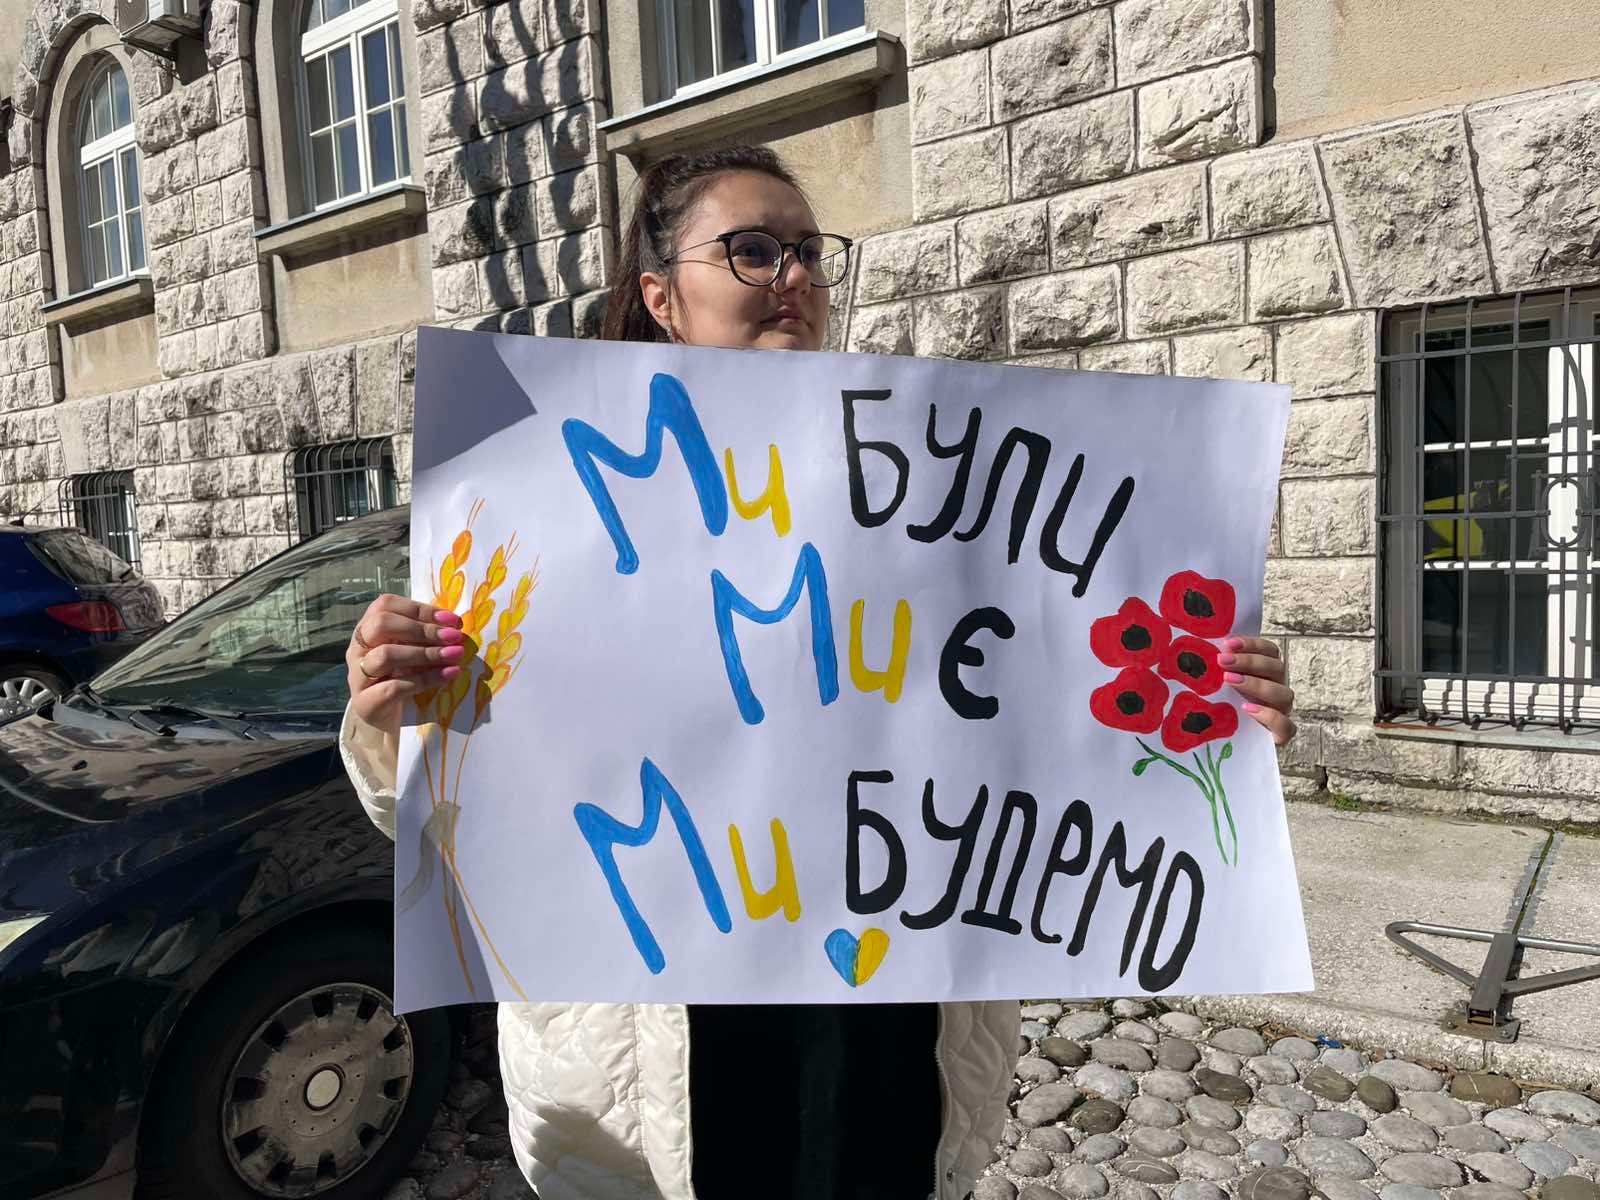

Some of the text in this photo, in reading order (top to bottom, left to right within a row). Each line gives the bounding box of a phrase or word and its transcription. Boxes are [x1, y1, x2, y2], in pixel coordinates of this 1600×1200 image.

[562, 372, 1135, 599] Ми БУЛИ
[710, 542, 913, 726] Ми
[573, 757, 803, 976] Ми
